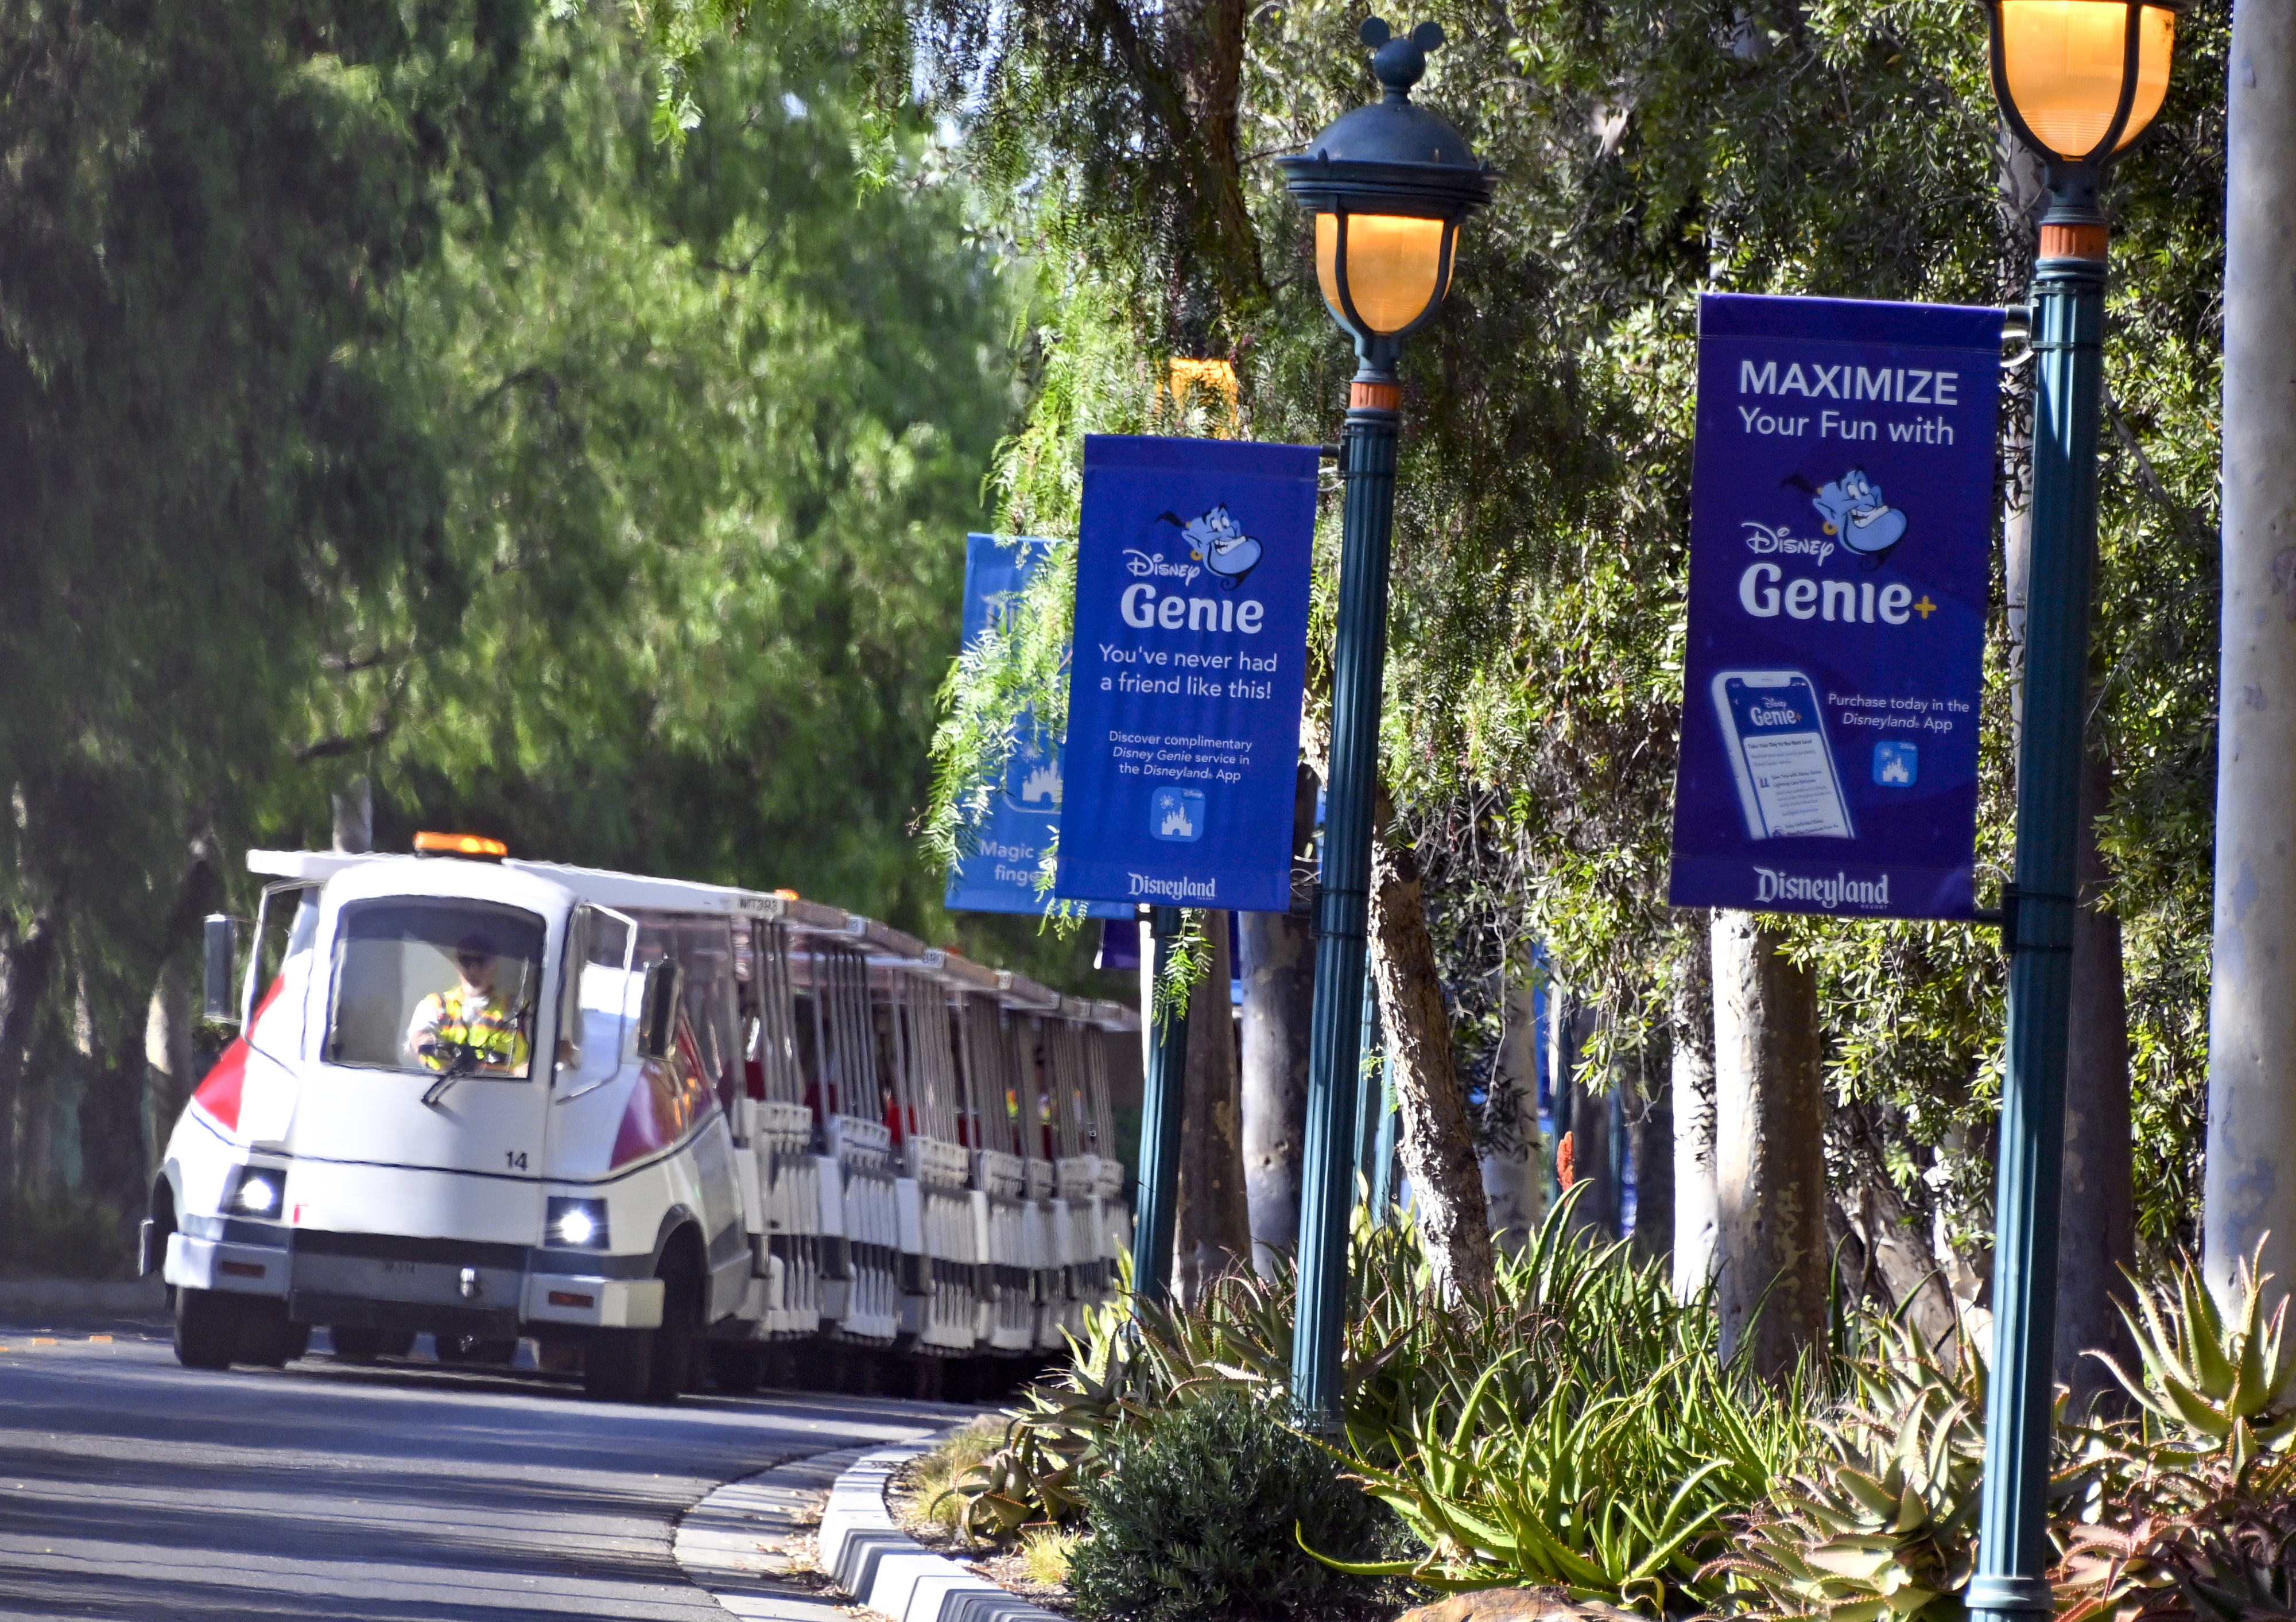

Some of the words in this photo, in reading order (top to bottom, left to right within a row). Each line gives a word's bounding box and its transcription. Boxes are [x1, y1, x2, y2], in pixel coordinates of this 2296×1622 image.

[1740, 360, 1959, 405] MAXIMIZE
[1737, 406, 1809, 437] Your
[1821, 411, 1877, 441] Fun
[1888, 416, 1954, 445] with
[1741, 522, 1835, 566] Disney
[1122, 549, 1200, 587] Disney
[1120, 583, 1263, 634] Genie
[1099, 643, 1168, 666] You've
[1174, 650, 1232, 669] never
[1239, 651, 1277, 672] had
[1100, 677, 1112, 690] a
[1118, 670, 1180, 694] friend
[1187, 675, 1222, 697] like
[1228, 678, 1271, 699] this!
[1828, 693, 1887, 708] Purchase
[1890, 697, 1928, 713] today
[1932, 699, 1944, 711] in
[1948, 699, 1969, 712] the
[1924, 717, 1953, 734] App
[1109, 730, 1161, 745] Discover
[1164, 735, 1252, 752] complimentary
[1112, 747, 1154, 762] Disney
[1157, 750, 1192, 762] Genie
[1195, 753, 1236, 765] service
[1239, 755, 1250, 765] in
[1119, 762, 1140, 775] the
[1216, 769, 1242, 783] App
[980, 840, 1034, 862] Magic
[1127, 872, 1216, 901] Disneyland
[1754, 866, 1889, 909] Disneyland
[506, 1151, 529, 1171] 14
